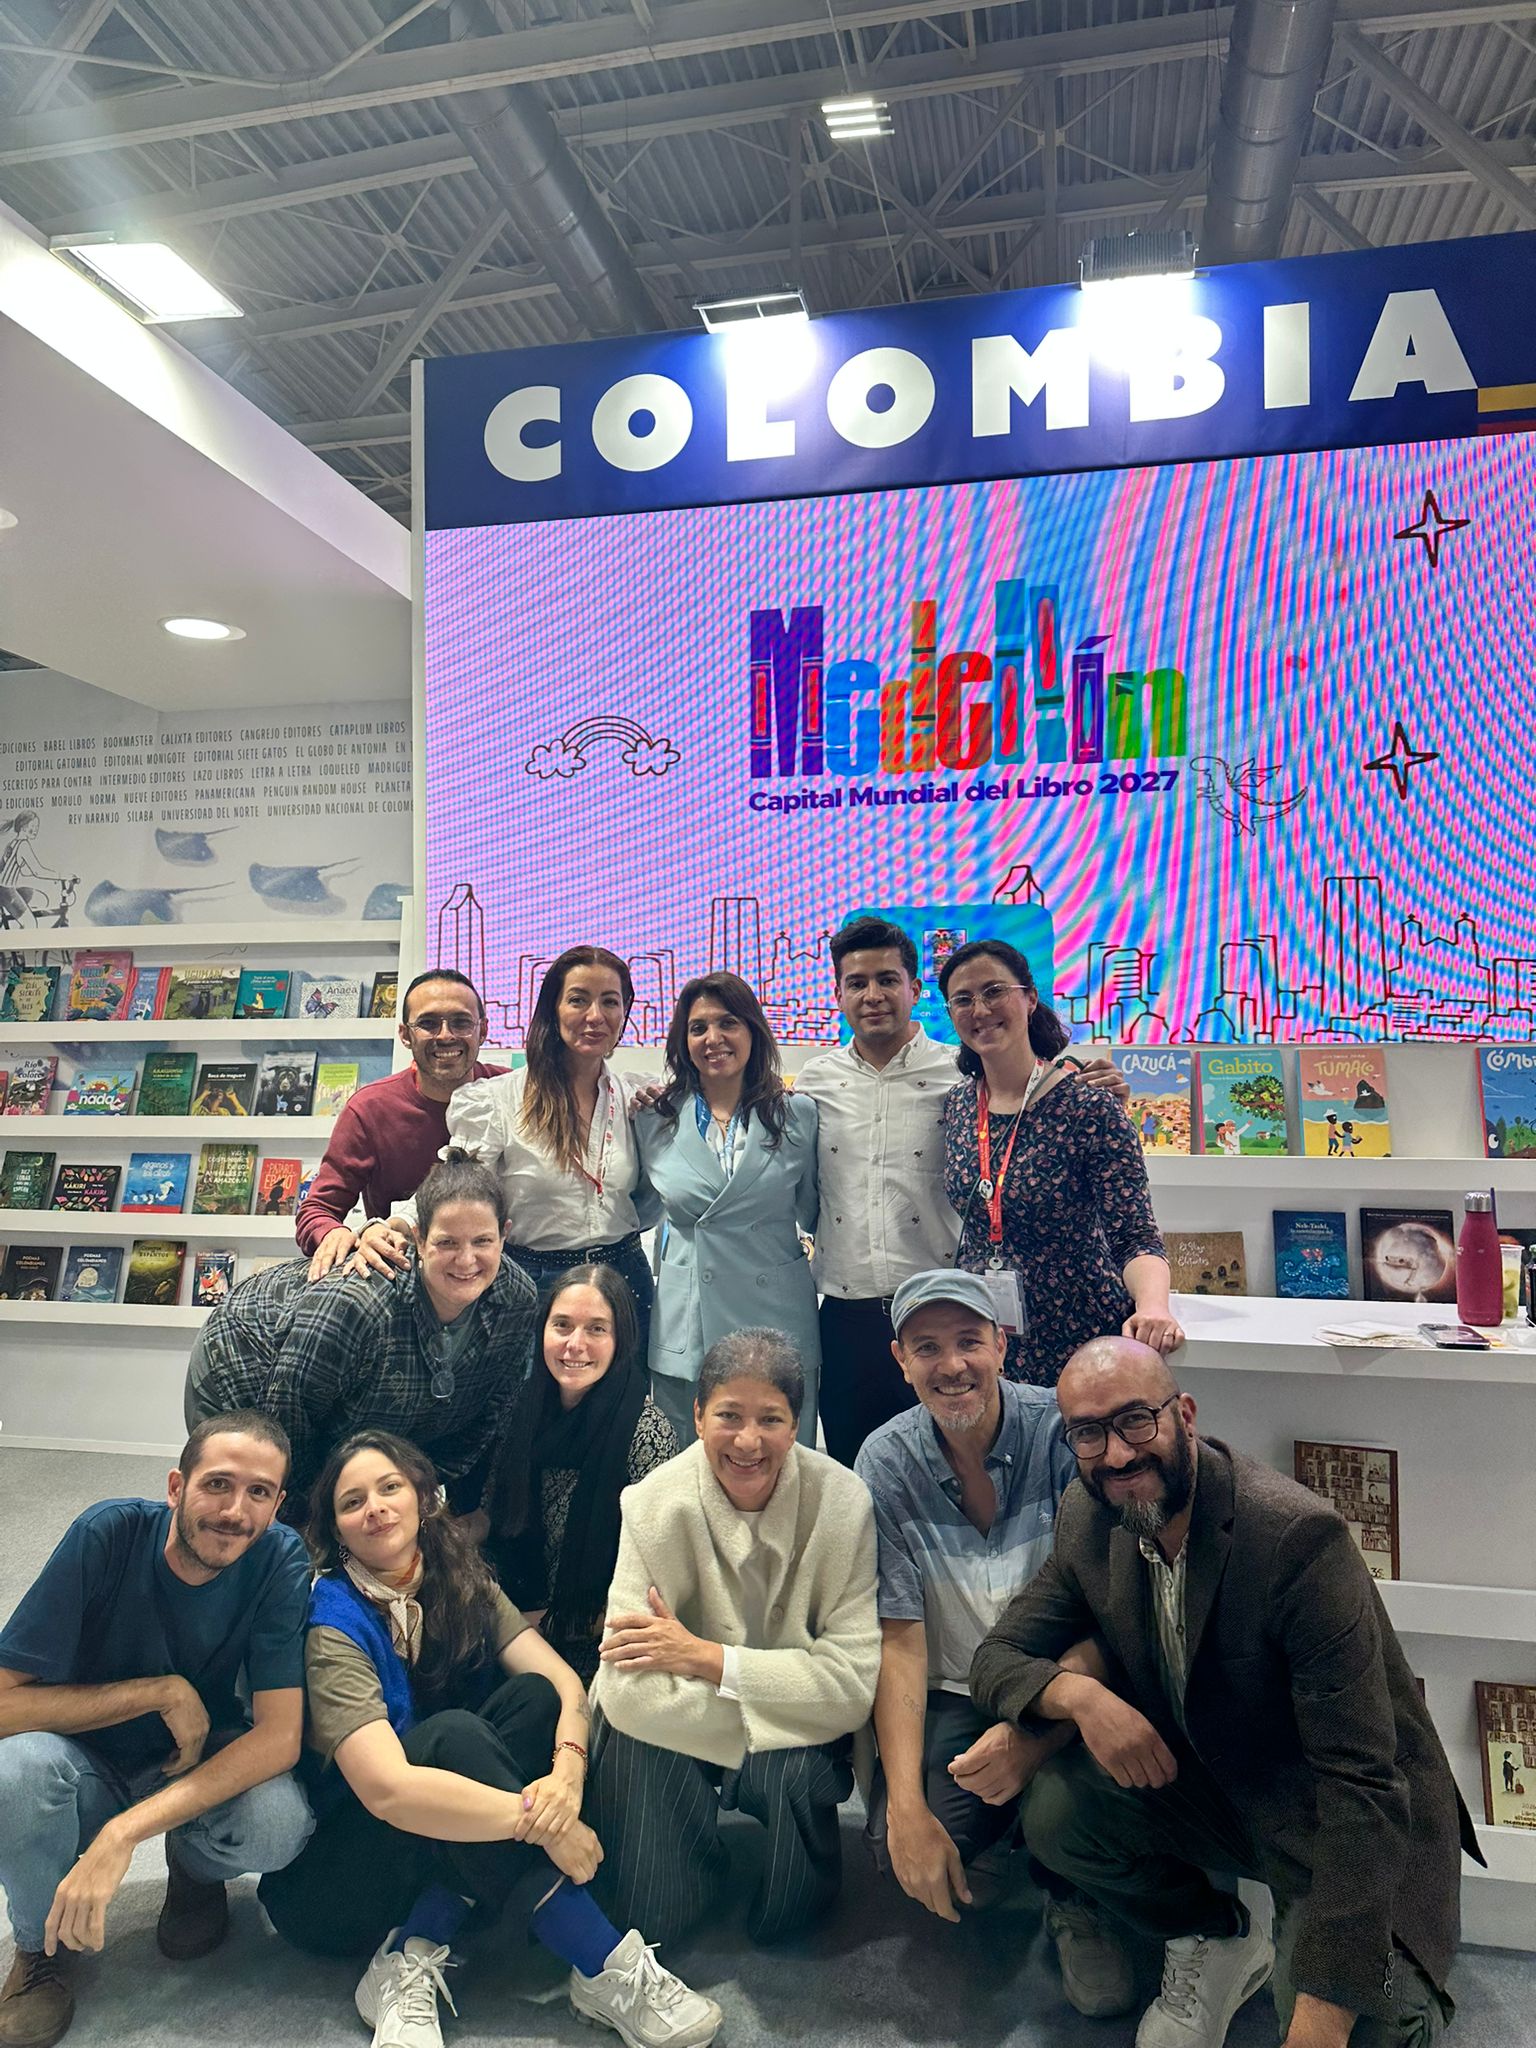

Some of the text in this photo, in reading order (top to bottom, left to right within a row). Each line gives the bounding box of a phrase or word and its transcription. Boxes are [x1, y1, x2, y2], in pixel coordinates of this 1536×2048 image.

[484, 289, 1478, 482] COLOMBIA
[750, 578, 1186, 777] Medellín
[44, 740, 65, 752] BABEL
[69, 738, 96, 750] LIBROS
[103, 735, 154, 748] BOOKMASTER
[161, 732, 192, 745] CALIXTA
[196, 730, 232, 743] EDITORES
[240, 727, 280, 741] CANGREJO
[284, 725, 321, 739] EDITORES
[329, 723, 372, 736] CATAPLUM
[376, 721, 406, 734] LIBROS
[15, 759, 53, 772] EDITORIAL
[57, 757, 96, 770] GATOMALO
[104, 754, 143, 767] EDITORIAL
[147, 752, 185, 765] MONIGOTE
[194, 749, 233, 763] EDITORIAL
[238, 748, 258, 761] SIETE
[262, 746, 287, 759] GATOS
[296, 746, 305, 758] EL
[307, 744, 333, 757] GLOBO
[337, 743, 347, 756] DE
[351, 741, 387, 755] ANTONIA
[396, 741, 406, 753] EN
[3, 760, 413, 791] SECRETOS PARA CONTAR INTERMEDIO EDITORES LAZO LIBROS LETRA A LETRA LOQUELEO MADRIGUE
[6, 796, 44, 810] EDICIONES
[90, 794, 116, 806] NORMA
[124, 792, 148, 804] NUEVE
[151, 790, 187, 803] EDITORES
[195, 787, 255, 801] PANAMERICANA
[263, 785, 299, 798] PENGUIN
[302, 783, 337, 796] RANDOM
[341, 782, 367, 795] HOUSE
[375, 780, 411, 794] PLANETA
[749, 770, 1180, 814] Capital Mundial del Libro 2027
[68, 813, 82, 825] REY
[85, 811, 119, 824] NARANJO
[162, 807, 213, 821] UNIVERSIDAD
[216, 806, 230, 819] DEL
[233, 805, 259, 818] NORTE
[267, 803, 321, 817] UNIVERSIDAD
[325, 801, 365, 815] NACIONAL
[369, 801, 379, 813] DE
[1121, 1052, 1176, 1075] CAZUCÁ
[1208, 1057, 1273, 1075] Gabito
[1313, 1060, 1374, 1078] TUMACO
[79, 1092, 115, 1105] nada
